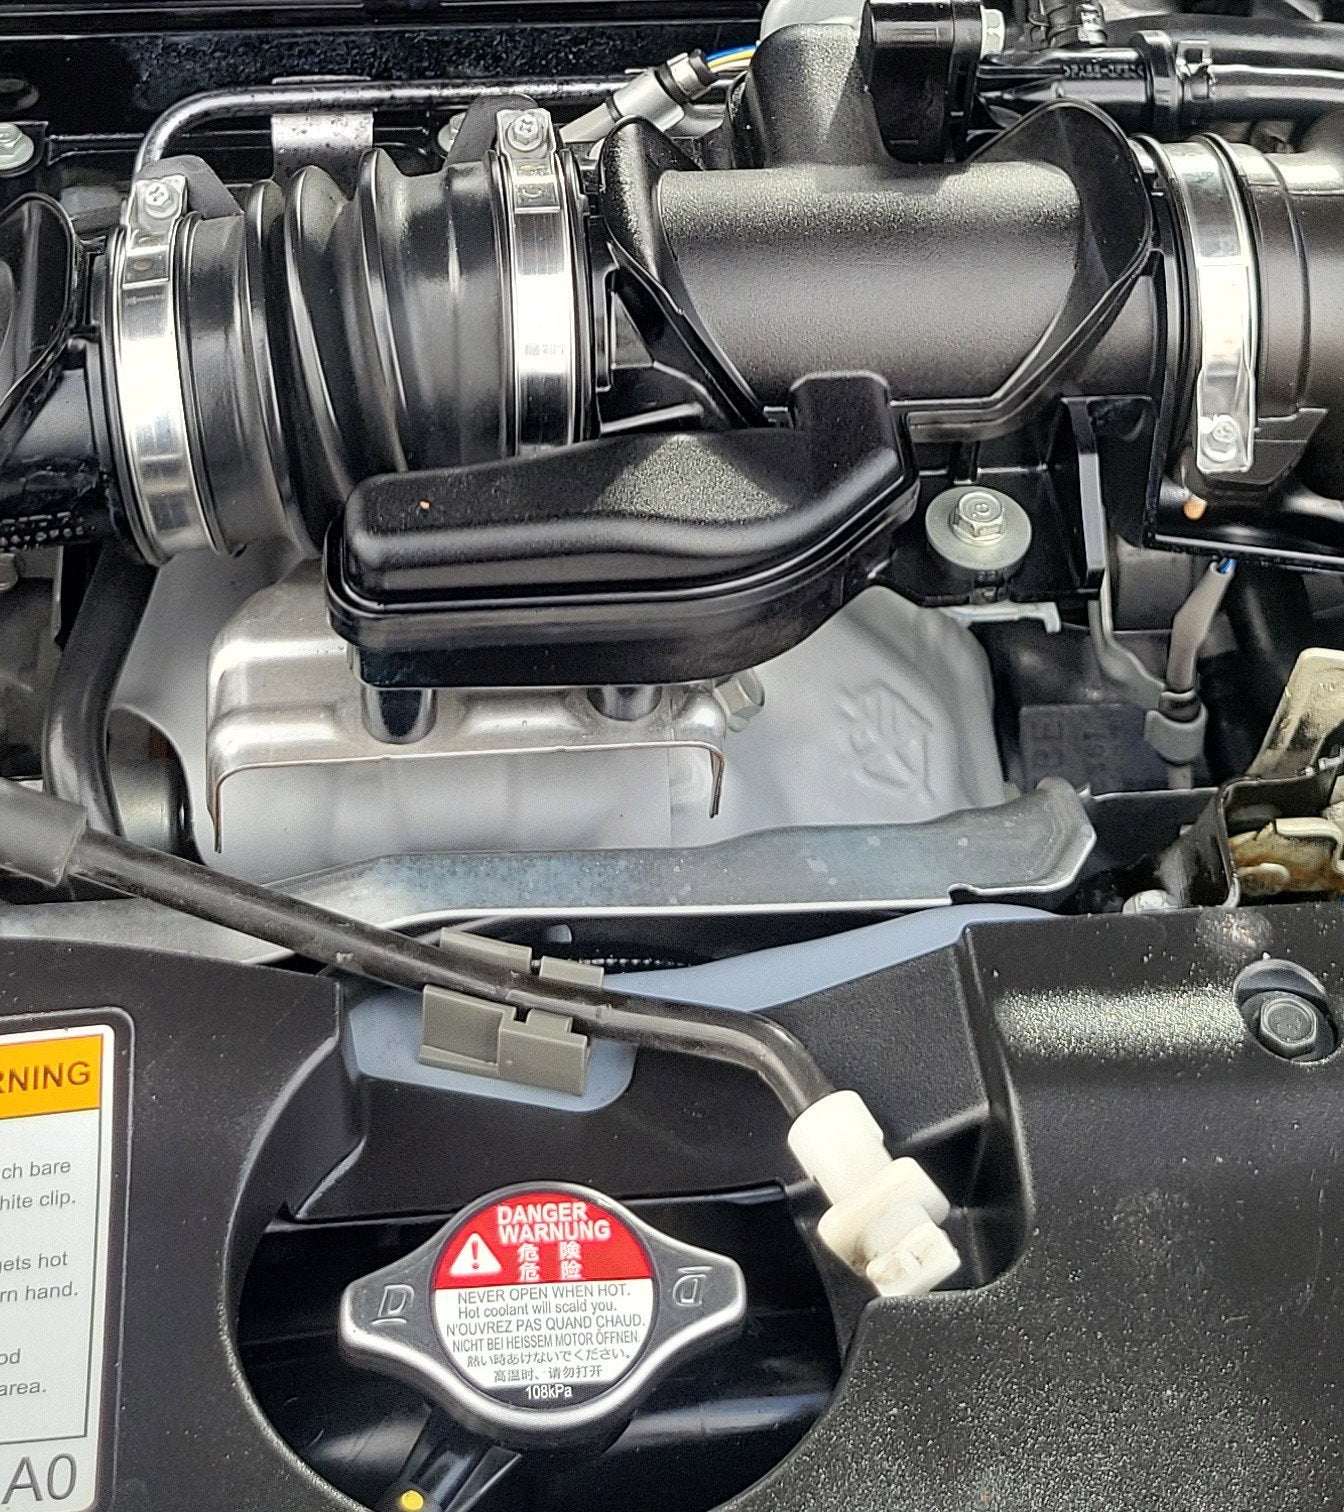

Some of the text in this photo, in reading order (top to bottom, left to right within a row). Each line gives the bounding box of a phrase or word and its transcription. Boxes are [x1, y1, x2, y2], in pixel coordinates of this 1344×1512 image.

[29, 1160, 71, 1178] bare
[39, 1189, 76, 1209] clip.
[497, 1202, 588, 1225] DANGER
[499, 1219, 611, 1245] WARNUNG
[37, 1251, 68, 1269] hot
[24, 1280, 78, 1301] hand.
[458, 1283, 631, 1305] NEVER OPEN WHEN HOT.
[458, 1299, 617, 1320] Hot coolant will scald you.
[446, 1313, 646, 1337] N'OUVREZ PAS QUAND CHAUD.
[452, 1338, 485, 1353] NICHT
[487, 1336, 504, 1351] BEI
[506, 1333, 553, 1349] HEISSEM
[555, 1332, 594, 1348] MOTOR
[525, 1383, 573, 1400] 108kPa
